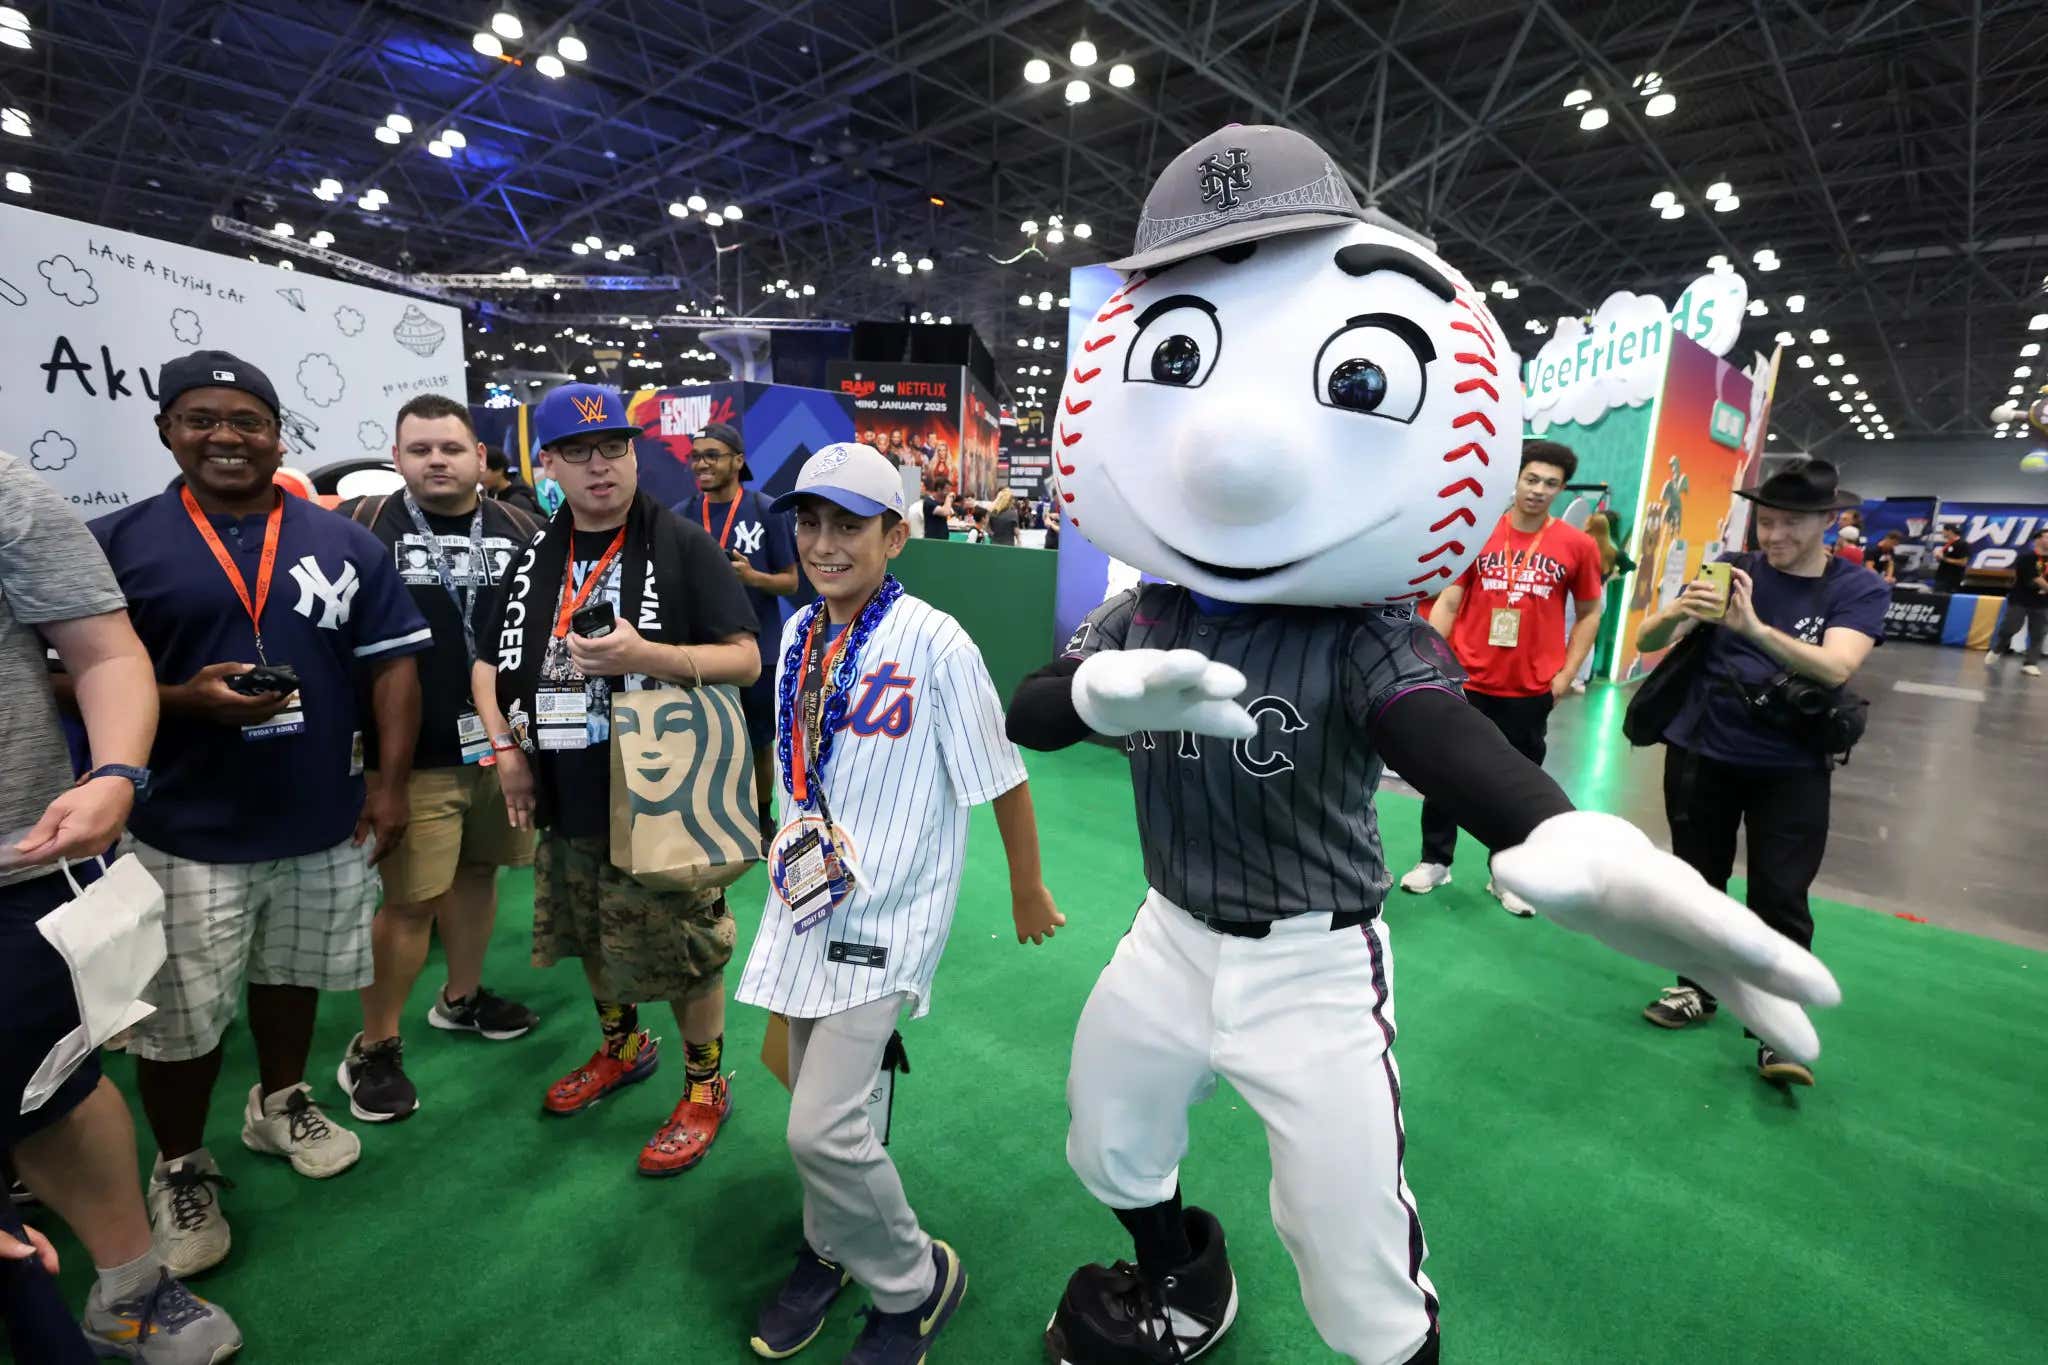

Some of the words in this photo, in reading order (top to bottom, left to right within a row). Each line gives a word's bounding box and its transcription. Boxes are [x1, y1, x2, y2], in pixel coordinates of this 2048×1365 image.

[144, 260, 155, 275] A
[1525, 290, 1715, 399] VeeFriends
[879, 401, 922, 411] JANUARY
[924, 403, 948, 412] 2025
[880, 384, 895, 393] ON
[897, 382, 947, 398] NETFLIX
[671, 394, 712, 436] SHOW
[734, 520, 766, 554] NY
[288, 555, 360, 631] NY
